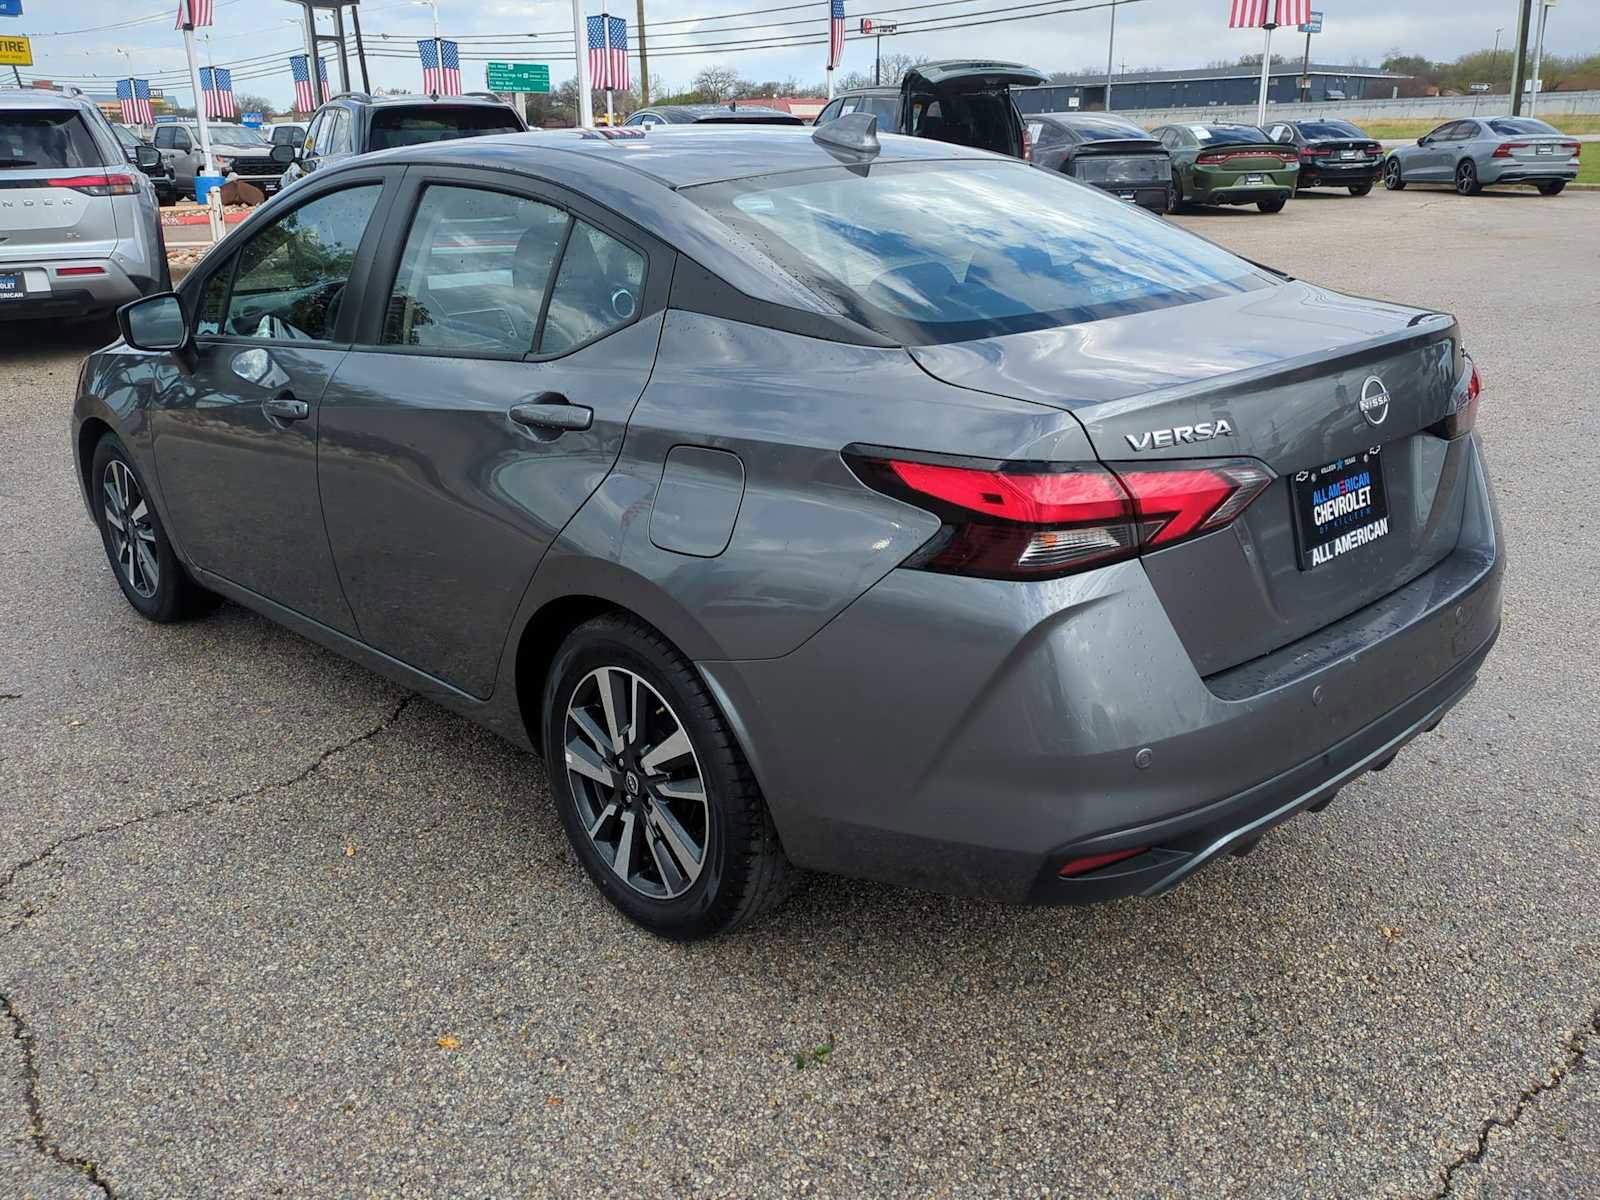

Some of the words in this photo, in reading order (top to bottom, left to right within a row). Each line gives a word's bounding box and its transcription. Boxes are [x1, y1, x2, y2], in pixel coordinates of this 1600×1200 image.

[1125, 418, 1233, 451] VERSA
[1313, 489, 1328, 506] ALL
[1328, 471, 1371, 500] AMERICAN
[1313, 486, 1371, 526] CHEVROLET
[1312, 542, 1334, 567] ALL
[1335, 518, 1388, 556] AMERICAN
